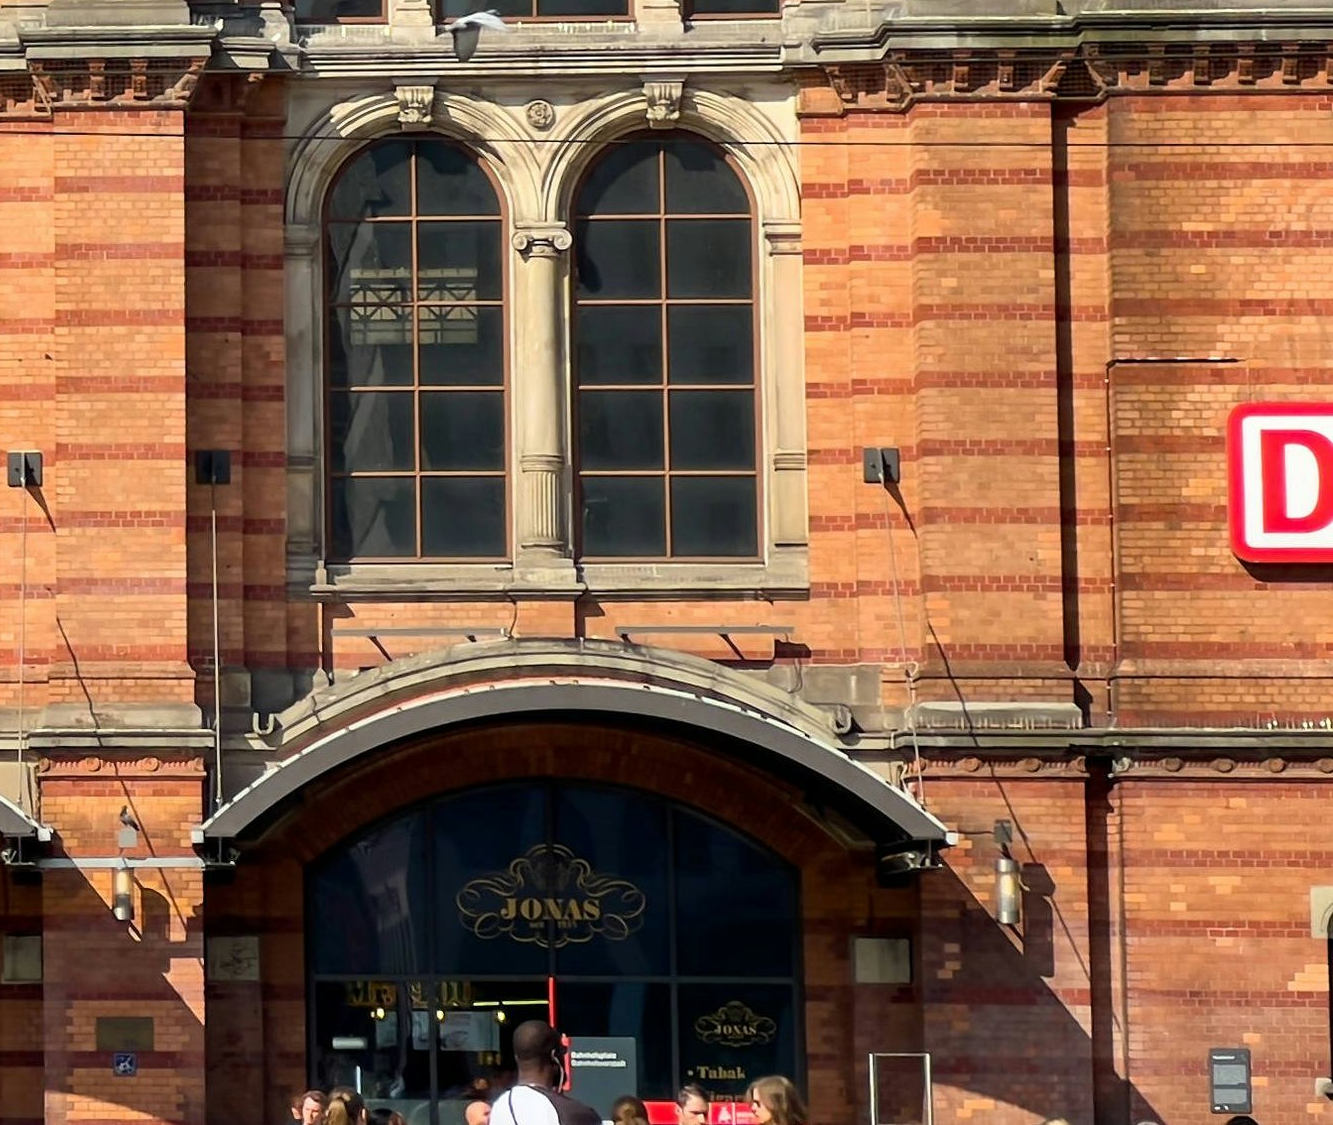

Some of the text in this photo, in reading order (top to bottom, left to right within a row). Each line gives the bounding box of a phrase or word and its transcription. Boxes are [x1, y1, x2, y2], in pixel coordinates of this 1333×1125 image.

[500, 897, 601, 921] JONAS
[714, 1024, 757, 1036] JONAS
[696, 1065, 746, 1079] Tabak
